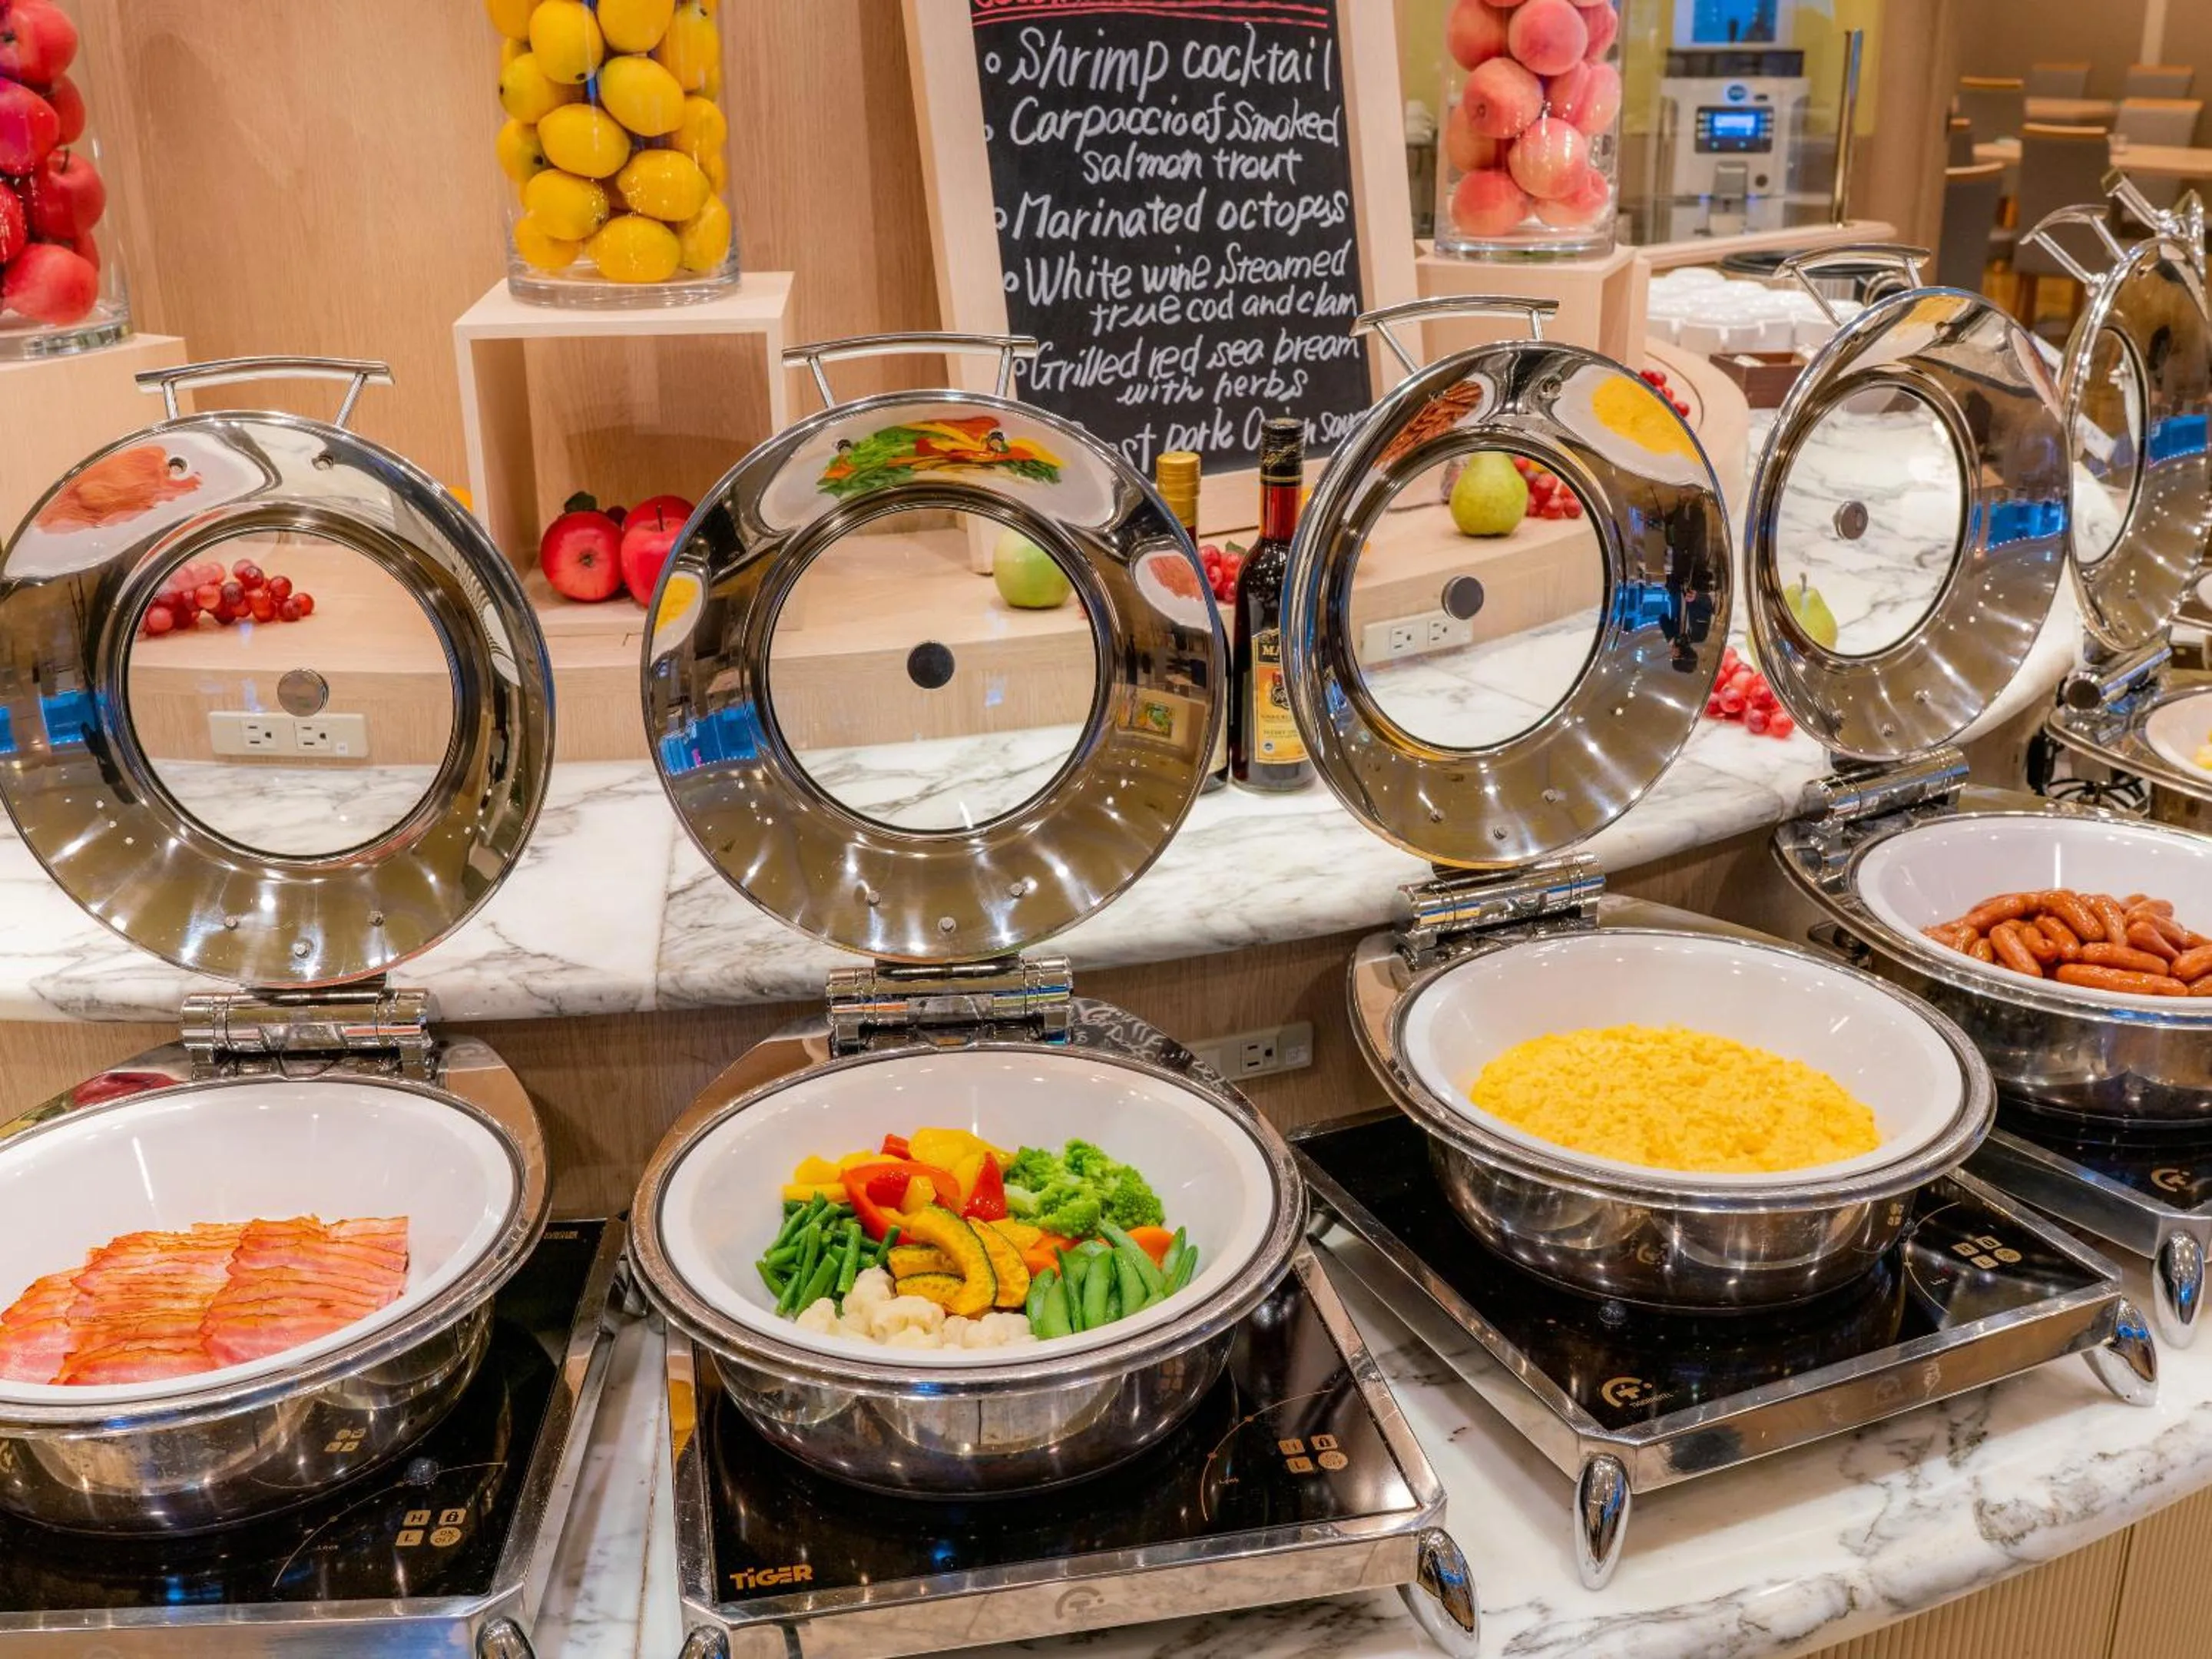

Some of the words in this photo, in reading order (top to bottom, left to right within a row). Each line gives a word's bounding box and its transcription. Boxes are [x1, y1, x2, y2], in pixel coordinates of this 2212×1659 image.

[1008, 27, 1169, 101] Shrimp
[1182, 22, 1332, 91] cocktail
[1082, 141, 1203, 184] salmon
[1213, 147, 1303, 185] trout
[1012, 187, 1207, 241] Marinated
[1217, 190, 1349, 237] octopus
[1025, 250, 1132, 306] White
[1141, 245, 1212, 294] wine
[1186, 289, 1234, 323] cod
[1240, 284, 1296, 317] and
[1296, 281, 1359, 317] clam
[1031, 336, 1143, 392] Grilled
[1147, 333, 1204, 379] red
[1205, 337, 1263, 370] sea
[1272, 328, 1360, 366] bream
[1116, 375, 1204, 406] with
[1214, 369, 1309, 402] herbs
[1164, 406, 1235, 452] pork
